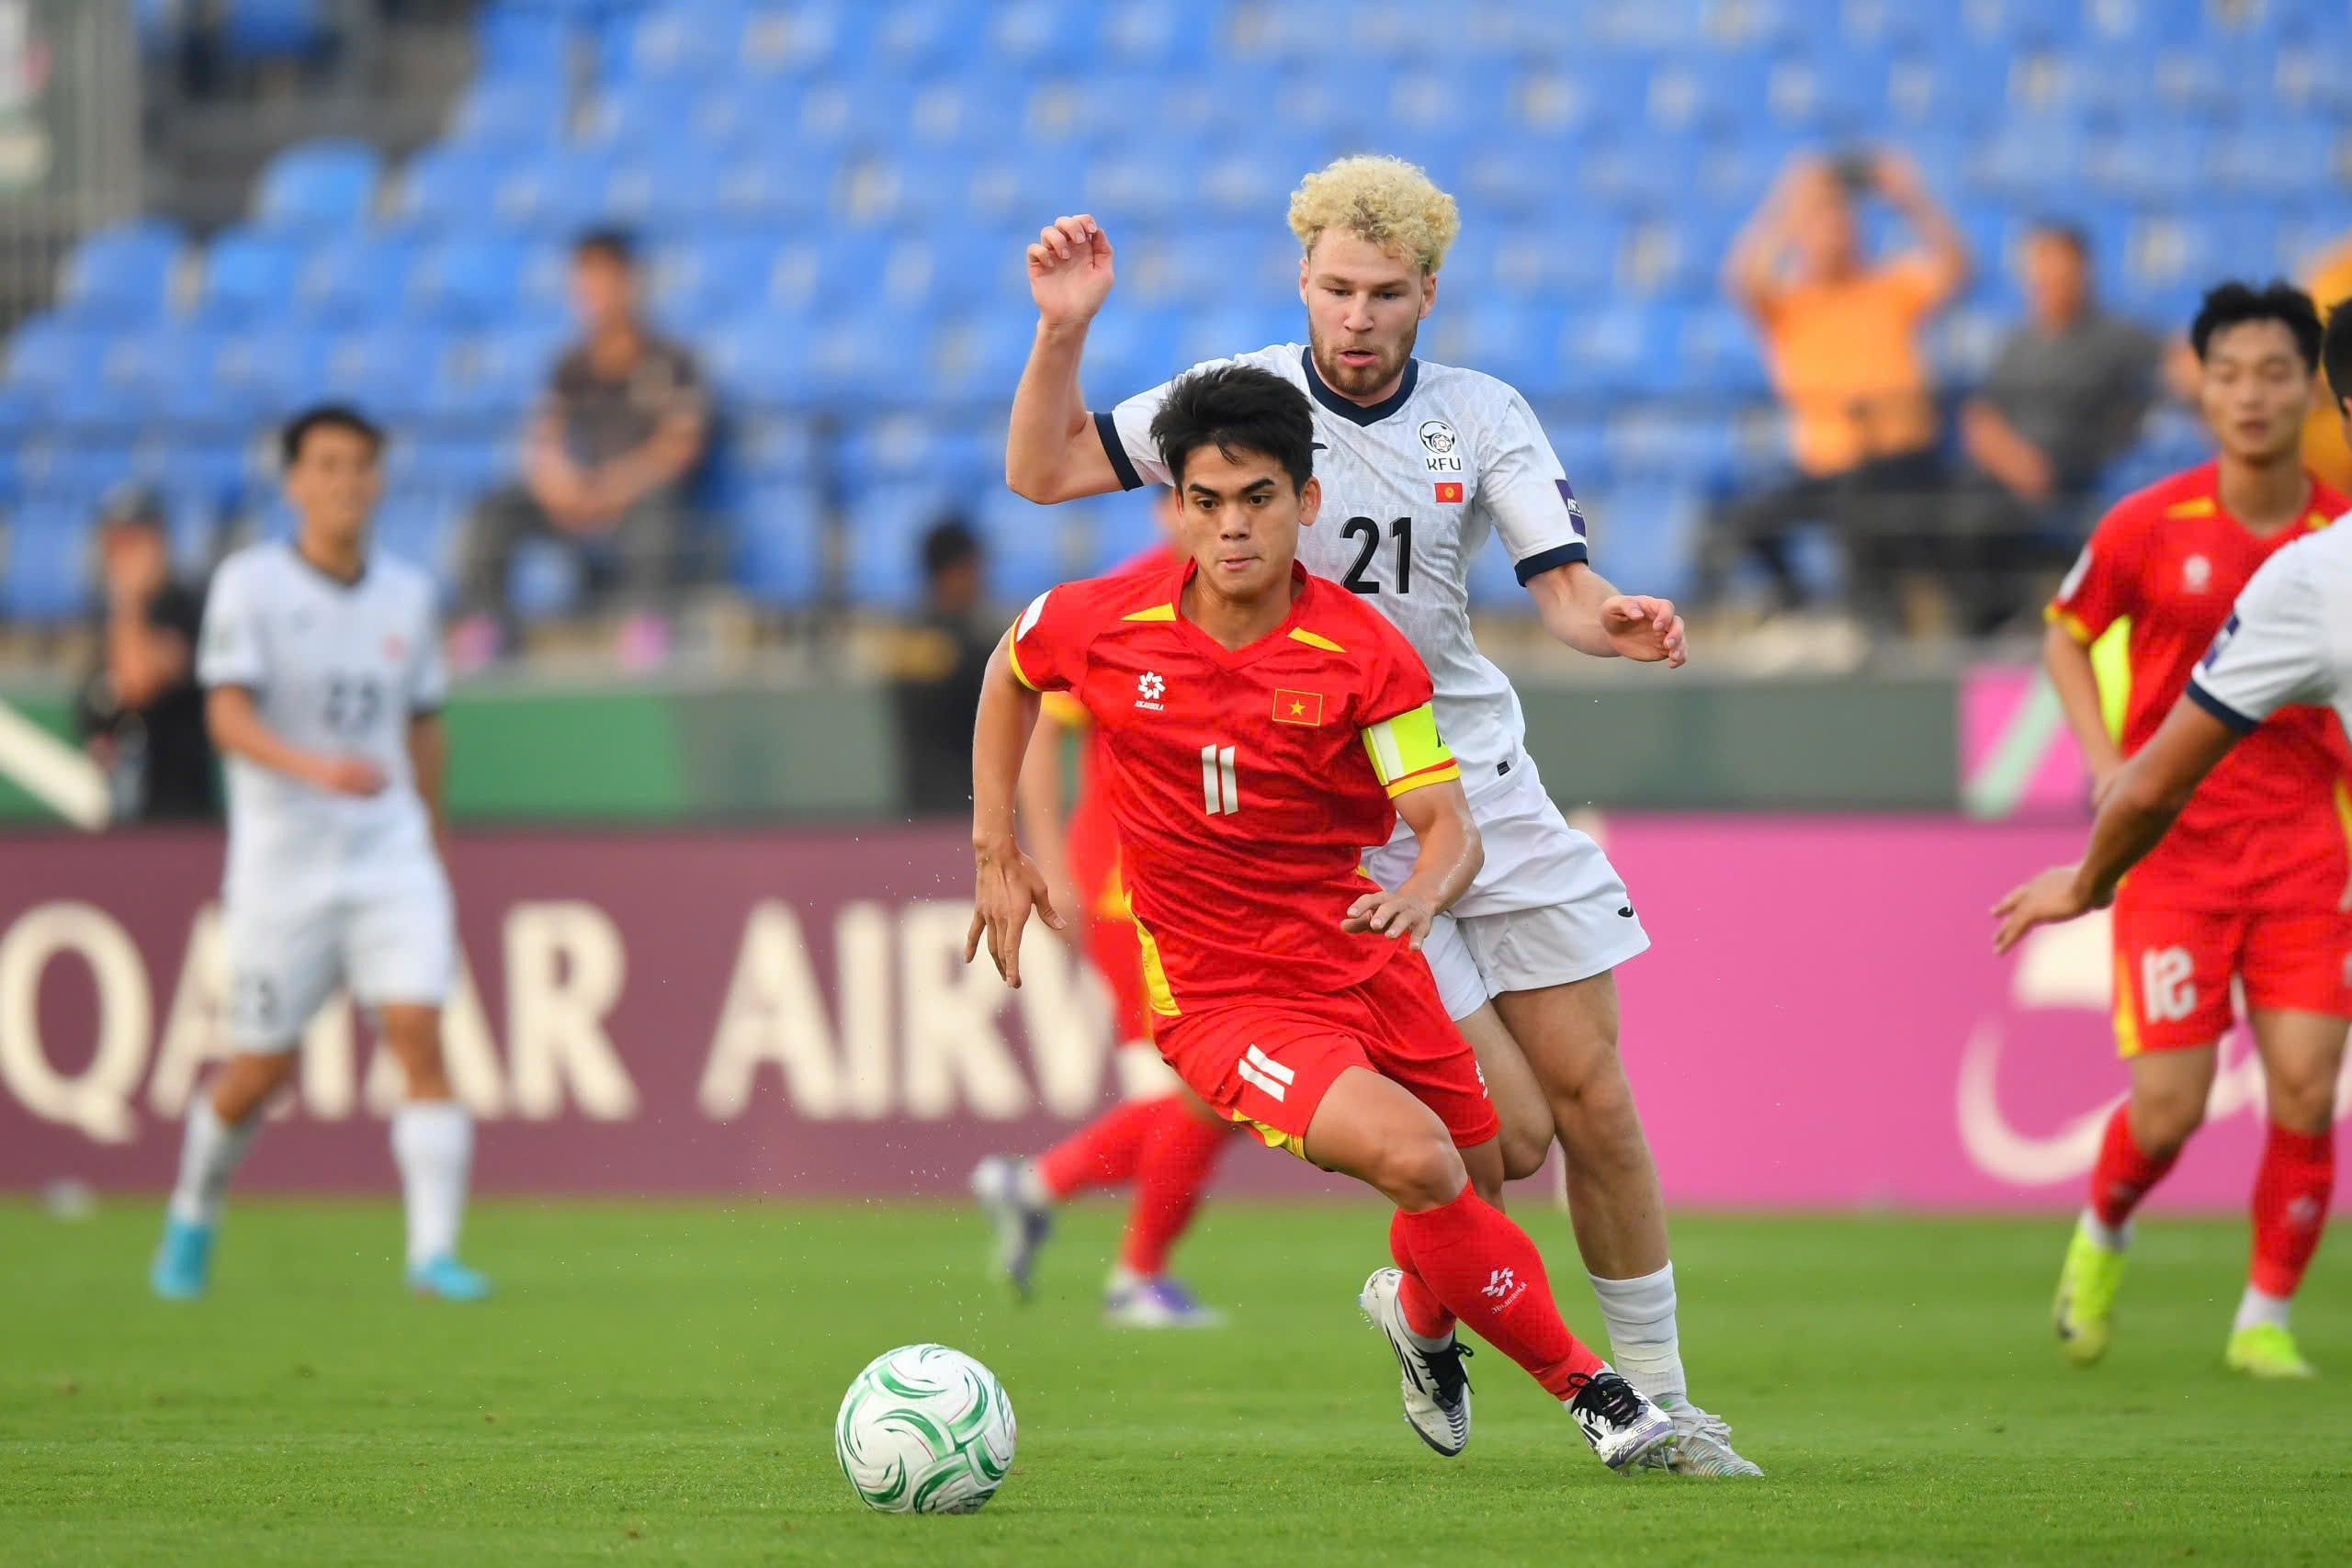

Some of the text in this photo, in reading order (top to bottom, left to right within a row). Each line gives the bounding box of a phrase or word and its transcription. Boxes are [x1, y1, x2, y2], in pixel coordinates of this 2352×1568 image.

[1426, 457, 1462, 471] KFU
[1340, 516, 1412, 594] 21
[1201, 743, 1238, 816] 11
[2141, 945, 2196, 1022] 12
[1238, 1043, 1295, 1102] 11
